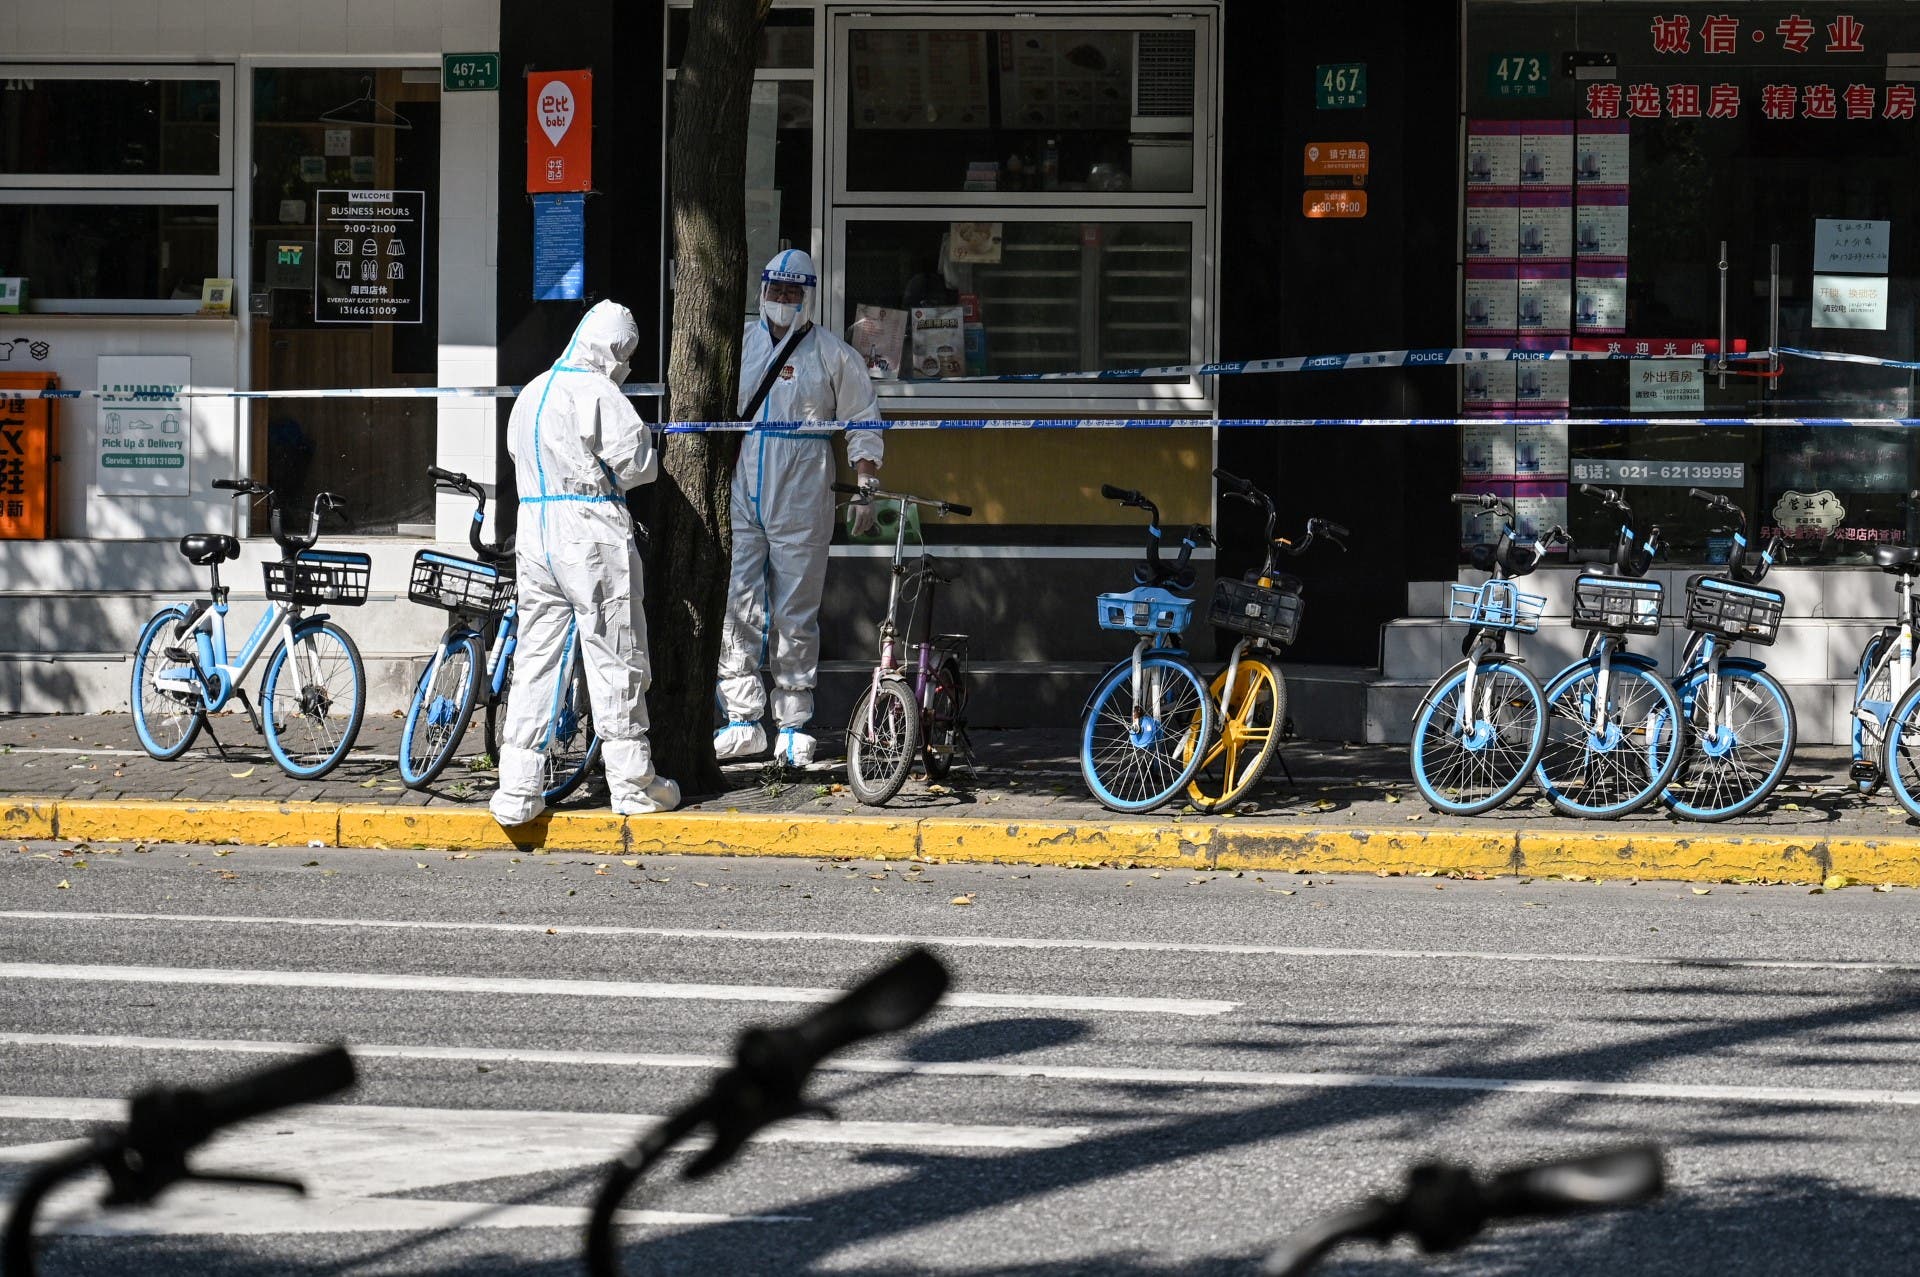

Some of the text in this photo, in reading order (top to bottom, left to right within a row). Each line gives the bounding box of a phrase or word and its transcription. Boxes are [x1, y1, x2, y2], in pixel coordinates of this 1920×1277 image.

[1650, 14, 1865, 54] 诚信·专业
[452, 62, 491, 76] 467-1
[1496, 57, 1540, 81] 473
[1323, 69, 1360, 91] 467
[542, 95, 569, 113] 巴比
[1586, 83, 1918, 120] 精选租房 精选售房
[351, 192, 390, 200] WELCOME
[331, 207, 410, 216] BUSINESS HOURS
[344, 224, 396, 233] 9:00-21:00
[340, 306, 397, 315] 13166131009
[1410, 353, 1444, 361] POLICE
[1512, 352, 1545, 360] POLICE
[1308, 358, 1342, 366] POLICE
[1207, 363, 1240, 371] POLICE
[1642, 370, 1693, 383] 外出看房
[102, 438, 183, 451] Pick Up & Delivery
[105, 456, 133, 465] Service:
